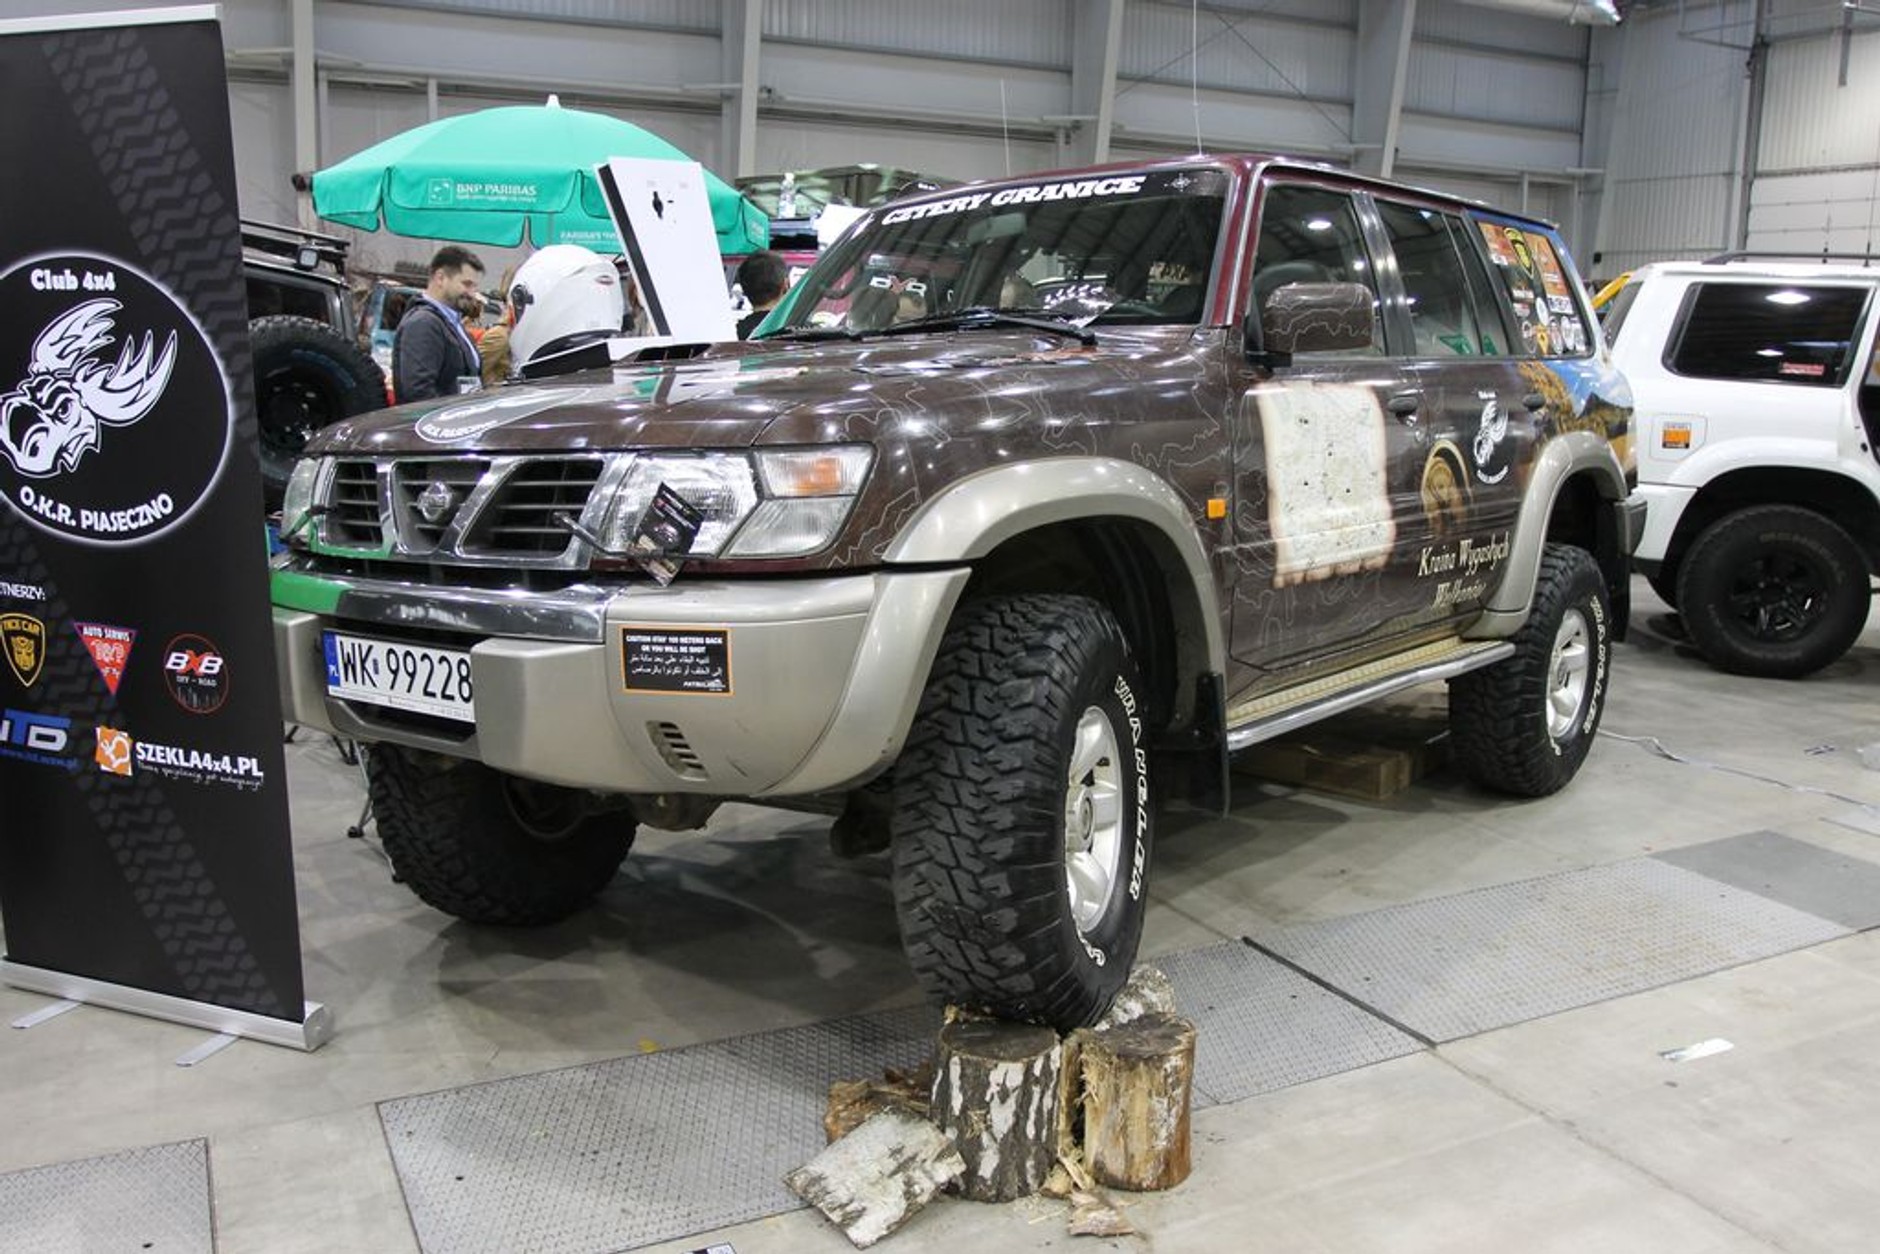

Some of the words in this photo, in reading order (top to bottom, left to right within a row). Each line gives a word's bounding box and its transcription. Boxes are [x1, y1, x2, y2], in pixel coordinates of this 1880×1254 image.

[457, 183, 482, 194] BNP
[485, 184, 537, 196] PARIBAS
[991, 176, 1146, 206] GRANICE
[30, 268, 79, 291] Club
[82, 271, 116, 291] 4x4
[19, 485, 77, 527] O.K.R.
[80, 493, 174, 532] PIASECZNO
[1418, 546, 1456, 576] Kraina
[339, 640, 377, 689] WK
[385, 647, 473, 704] 99228
[135, 742, 264, 776] SZEKLA4x4.PL
[1115, 675, 1149, 901] WRANGLER
